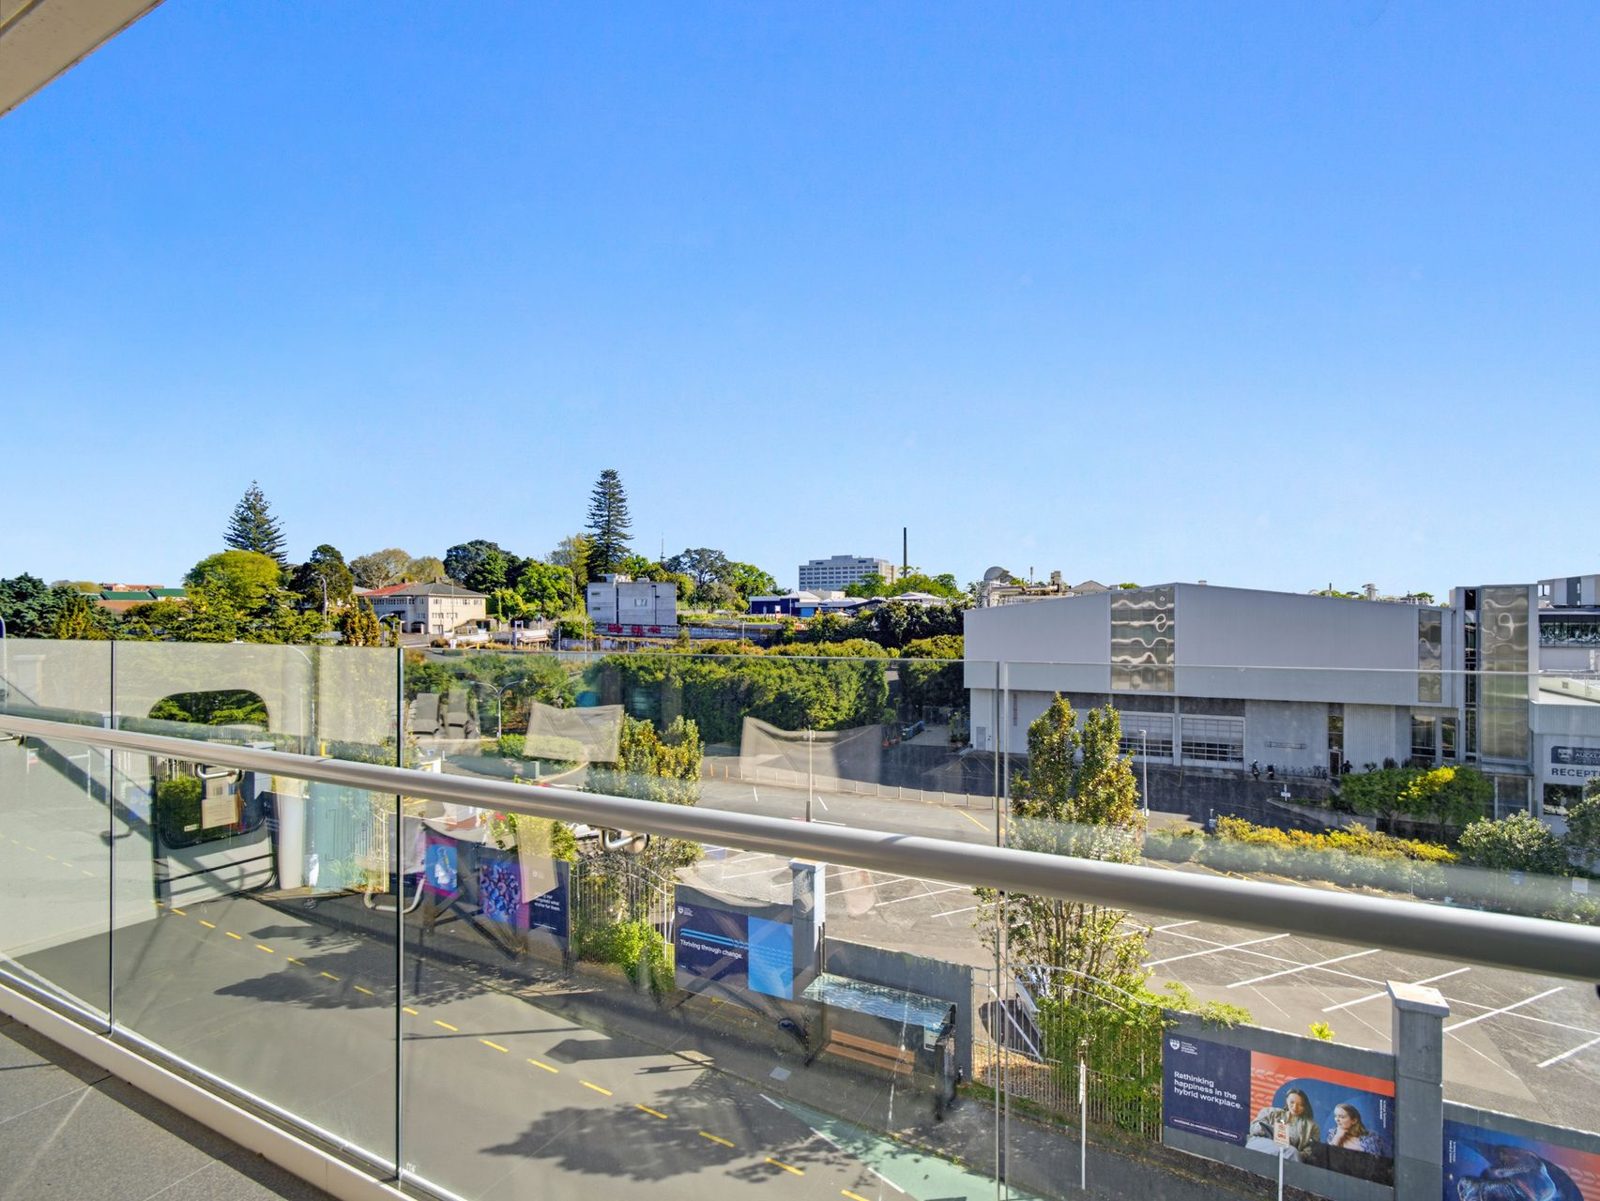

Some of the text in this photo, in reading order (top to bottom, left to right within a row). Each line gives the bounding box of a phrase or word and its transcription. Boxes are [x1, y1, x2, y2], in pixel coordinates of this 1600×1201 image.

[680, 939, 700, 950] Thriving
[701, 944, 721, 955] through
[1174, 1071, 1215, 1088] Rethinking
[1174, 1079, 1237, 1100] happiness in the
[1174, 1086, 1243, 1110] hybrid workplace.
